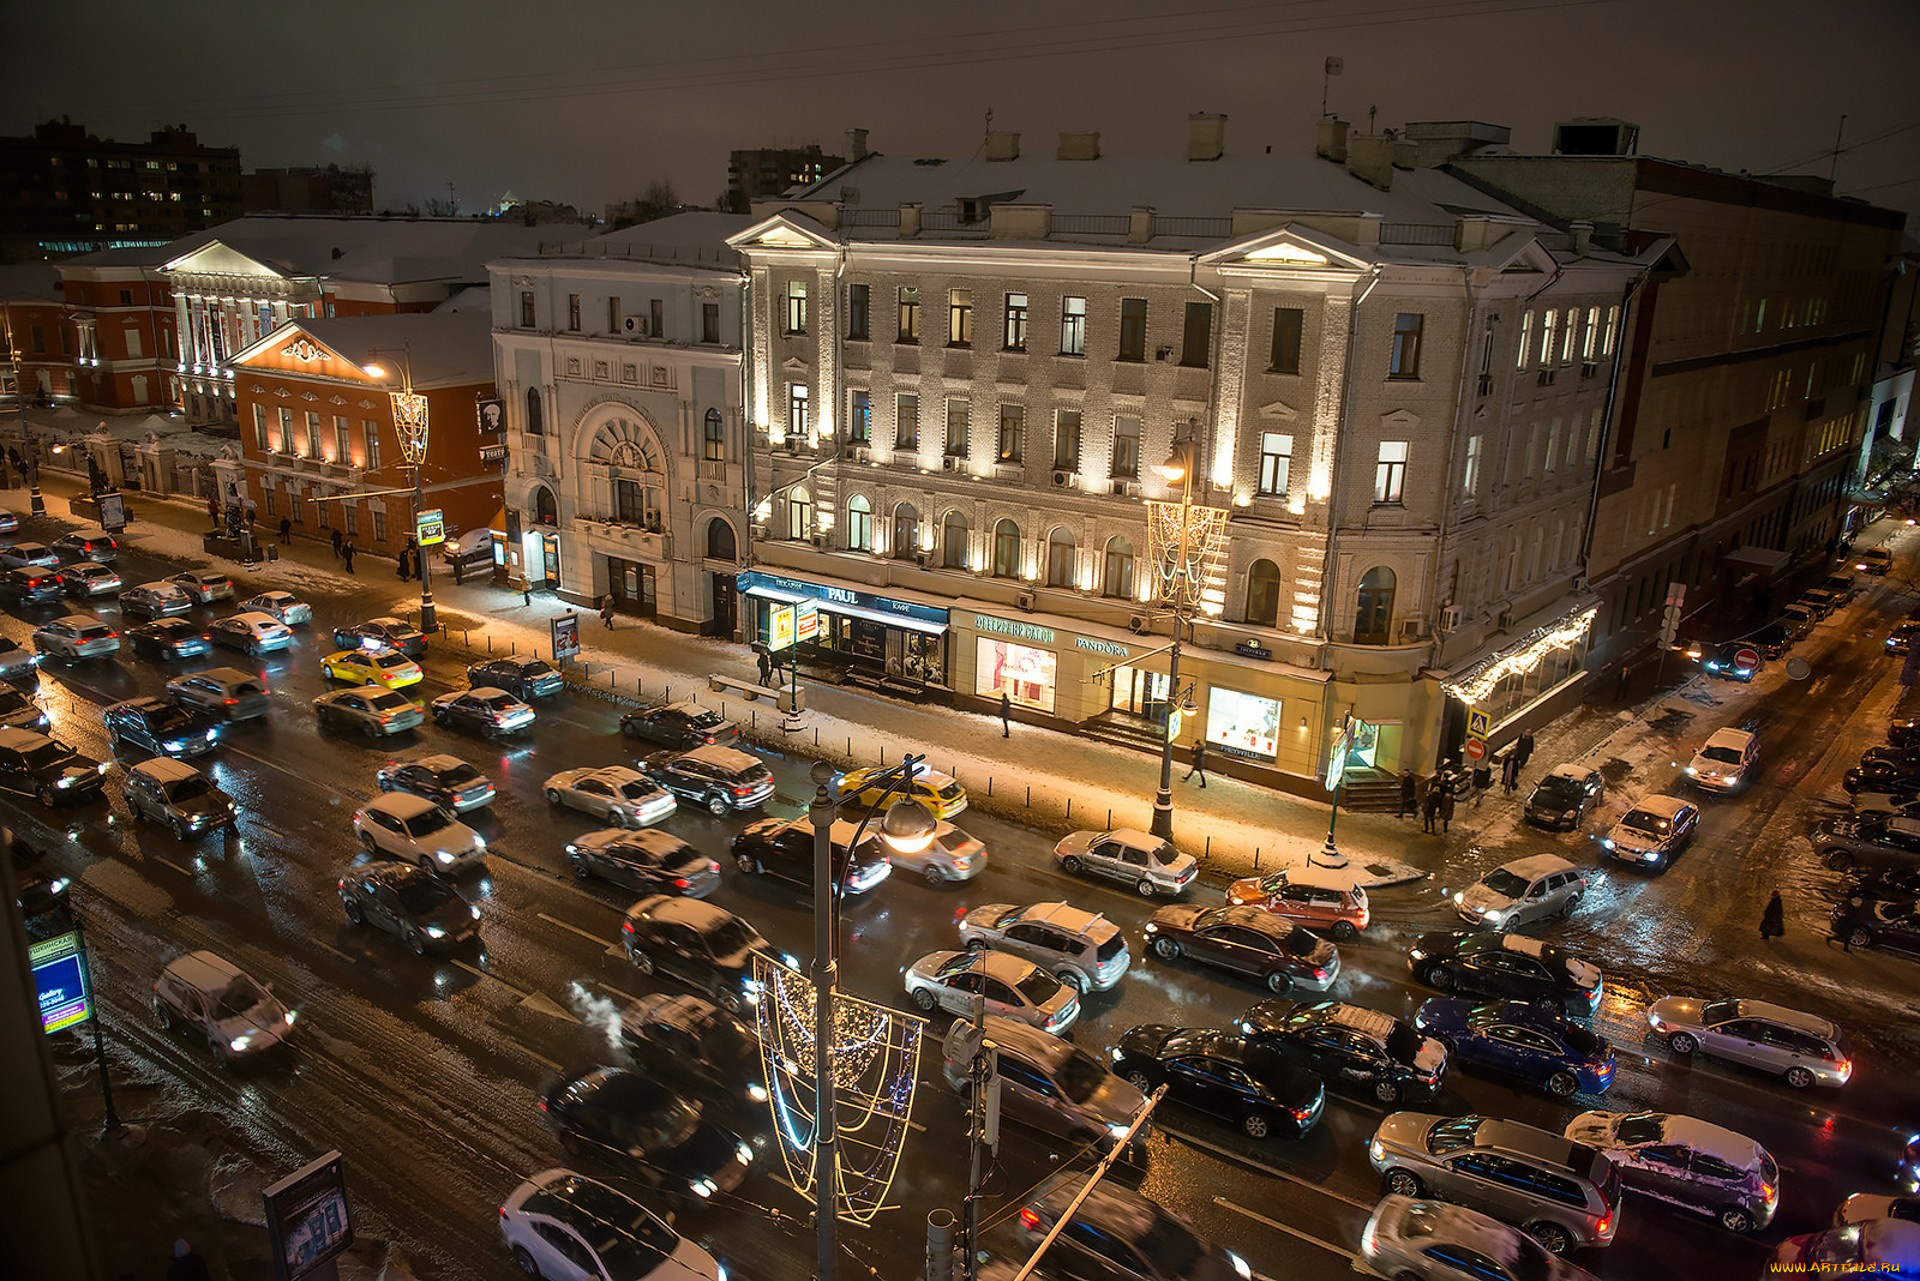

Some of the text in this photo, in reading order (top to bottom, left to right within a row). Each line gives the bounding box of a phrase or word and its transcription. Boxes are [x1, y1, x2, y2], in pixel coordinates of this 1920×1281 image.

[828, 587, 858, 604] PAUL
[892, 601, 911, 612] КАФЕ
[1075, 637, 1128, 658] PANDORA
